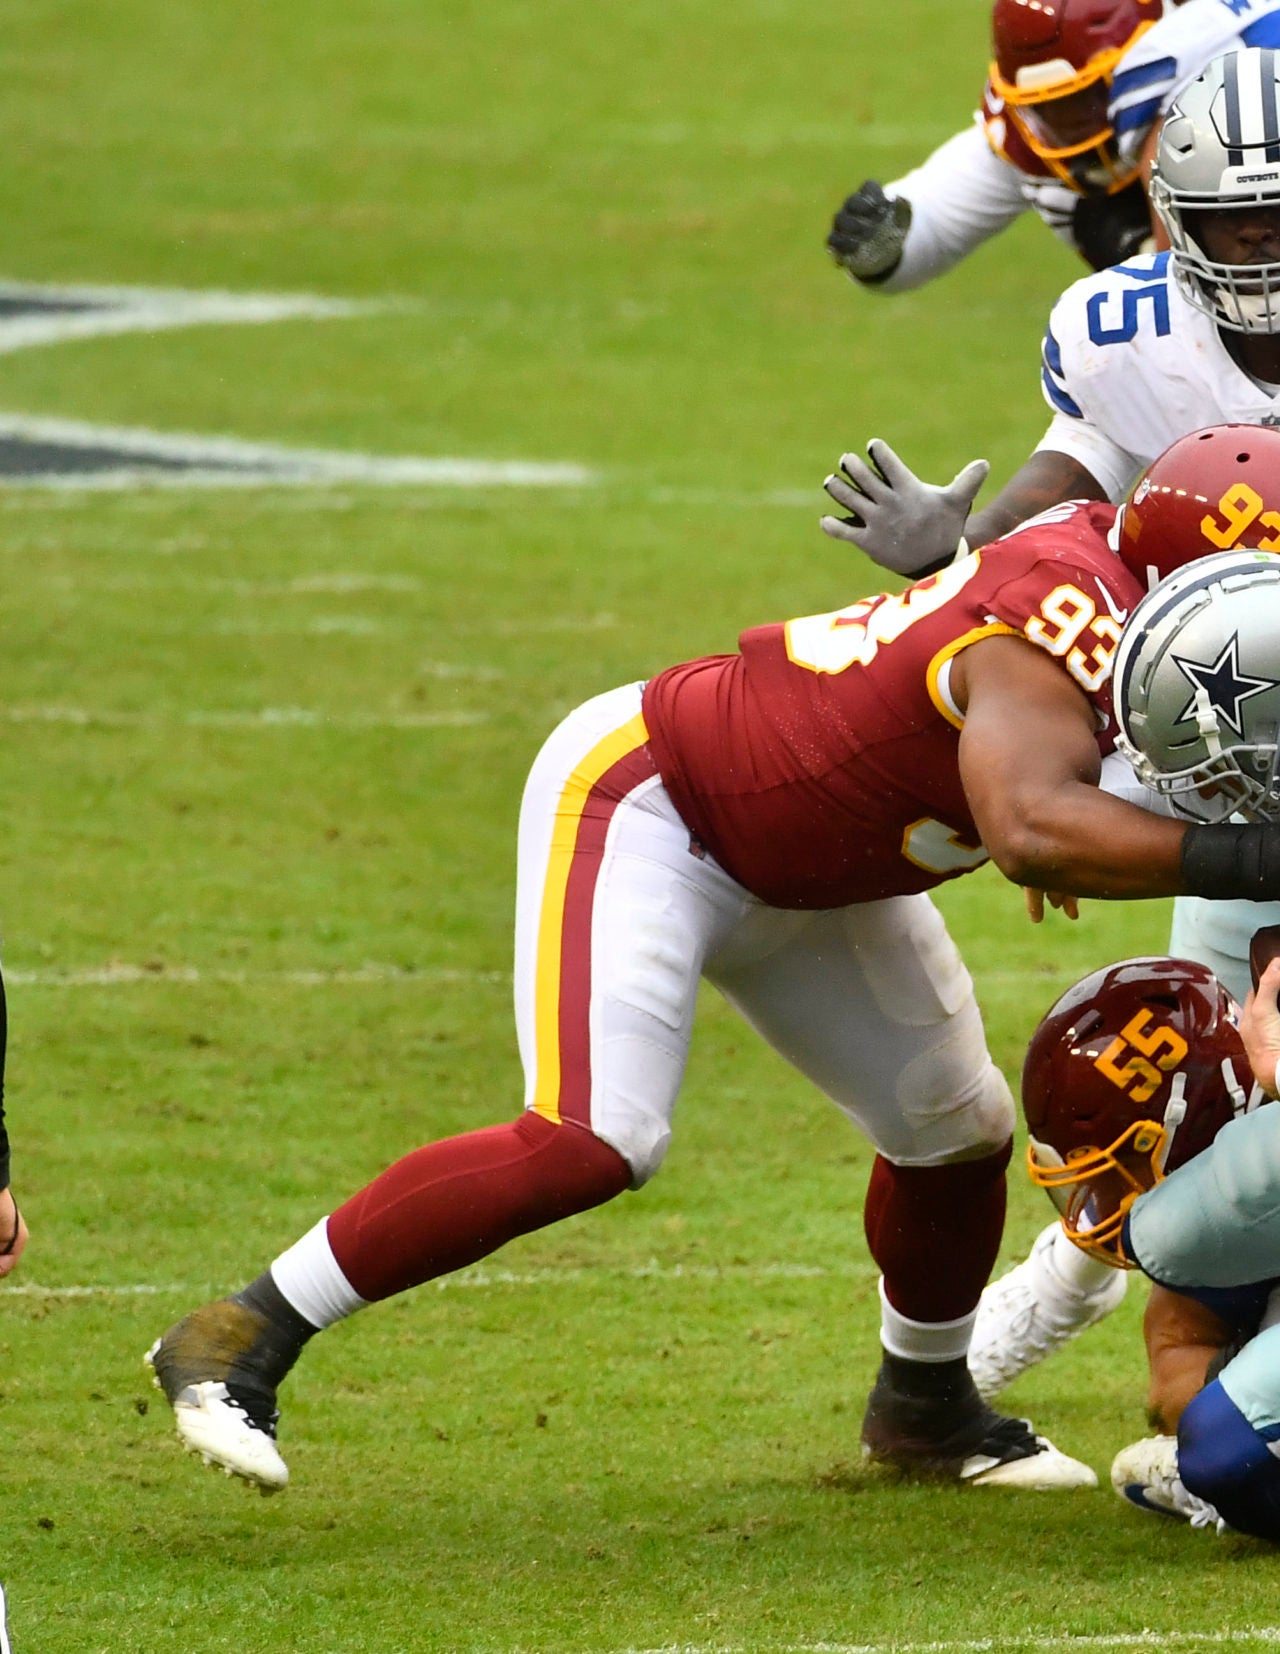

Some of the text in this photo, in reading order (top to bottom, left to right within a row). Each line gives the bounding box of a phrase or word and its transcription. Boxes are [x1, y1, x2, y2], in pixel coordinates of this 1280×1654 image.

[1236, 172, 1279, 184] COWBOYS
[1086, 250, 1171, 347] 75
[1024, 583, 1124, 692] 93
[1093, 1007, 1189, 1103] 55
